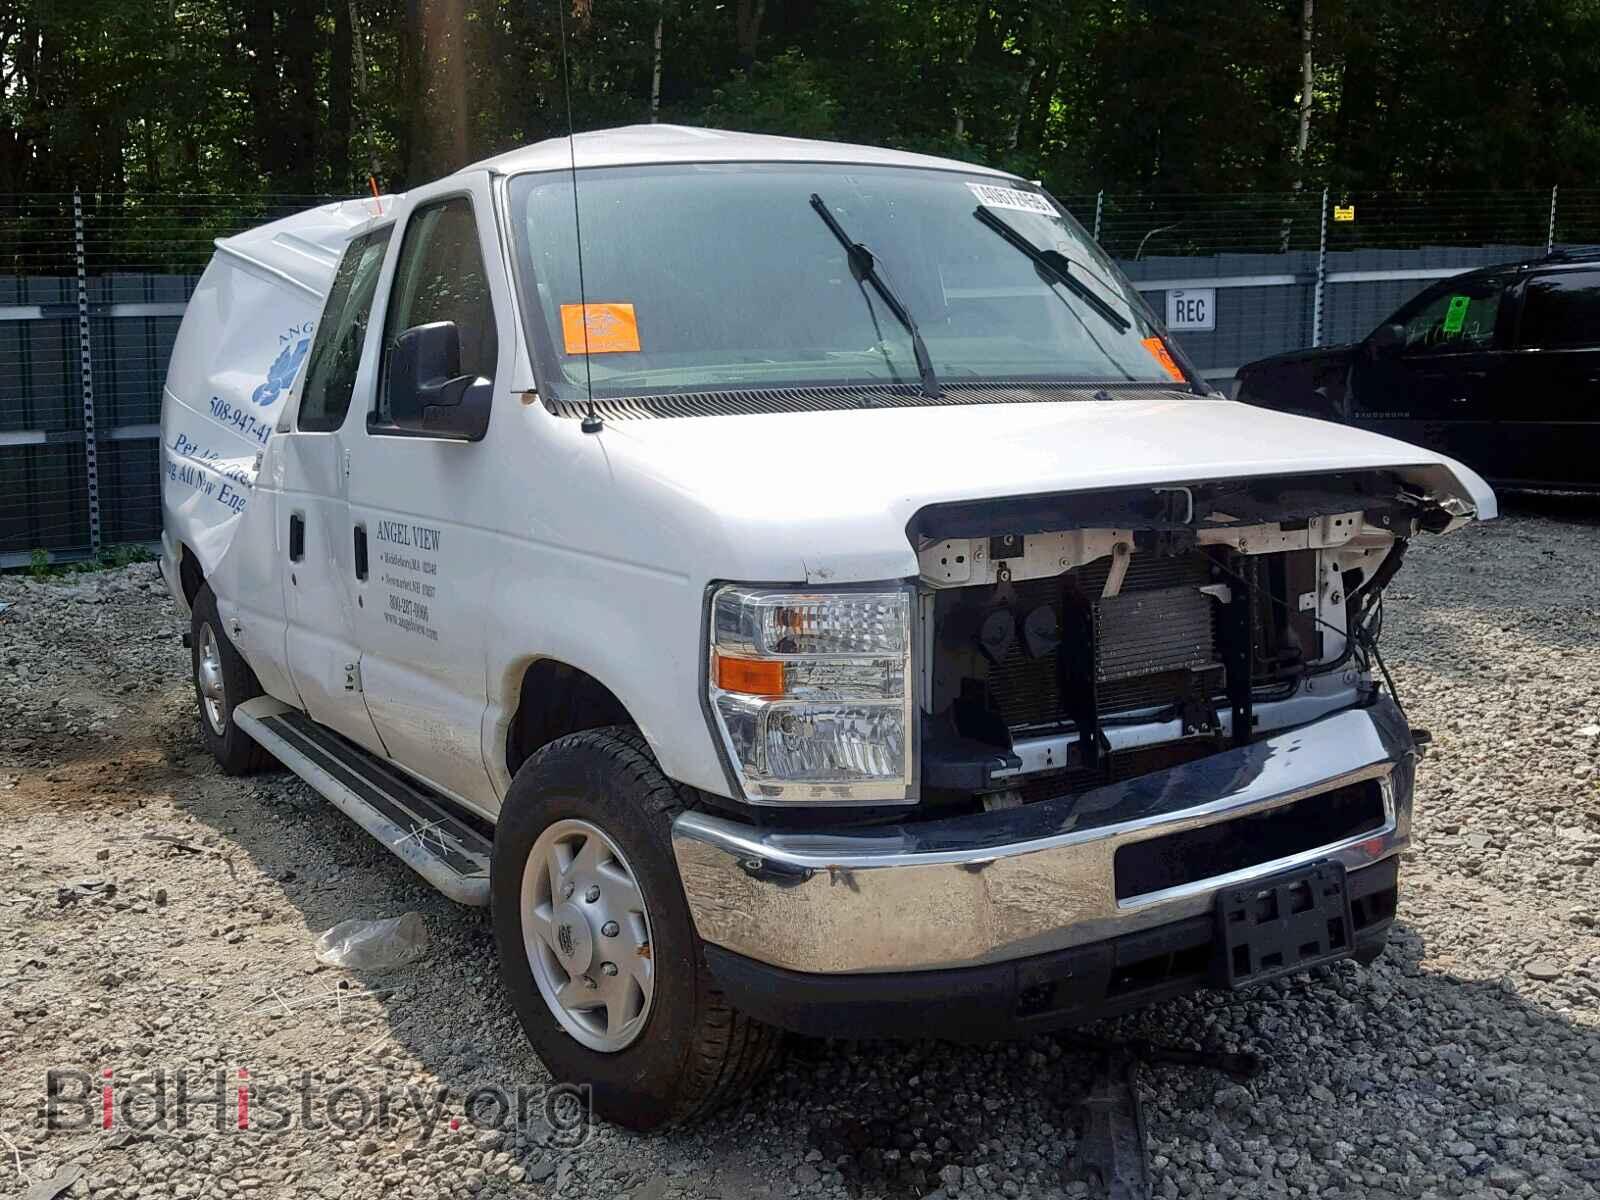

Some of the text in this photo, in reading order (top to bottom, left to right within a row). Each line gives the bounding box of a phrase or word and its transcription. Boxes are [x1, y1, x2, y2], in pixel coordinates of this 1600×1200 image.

[1176, 299, 1205, 322] REC
[174, 433, 198, 456] Pet
[179, 464, 195, 486] All
[376, 521, 441, 552] ANGEL VIEW
